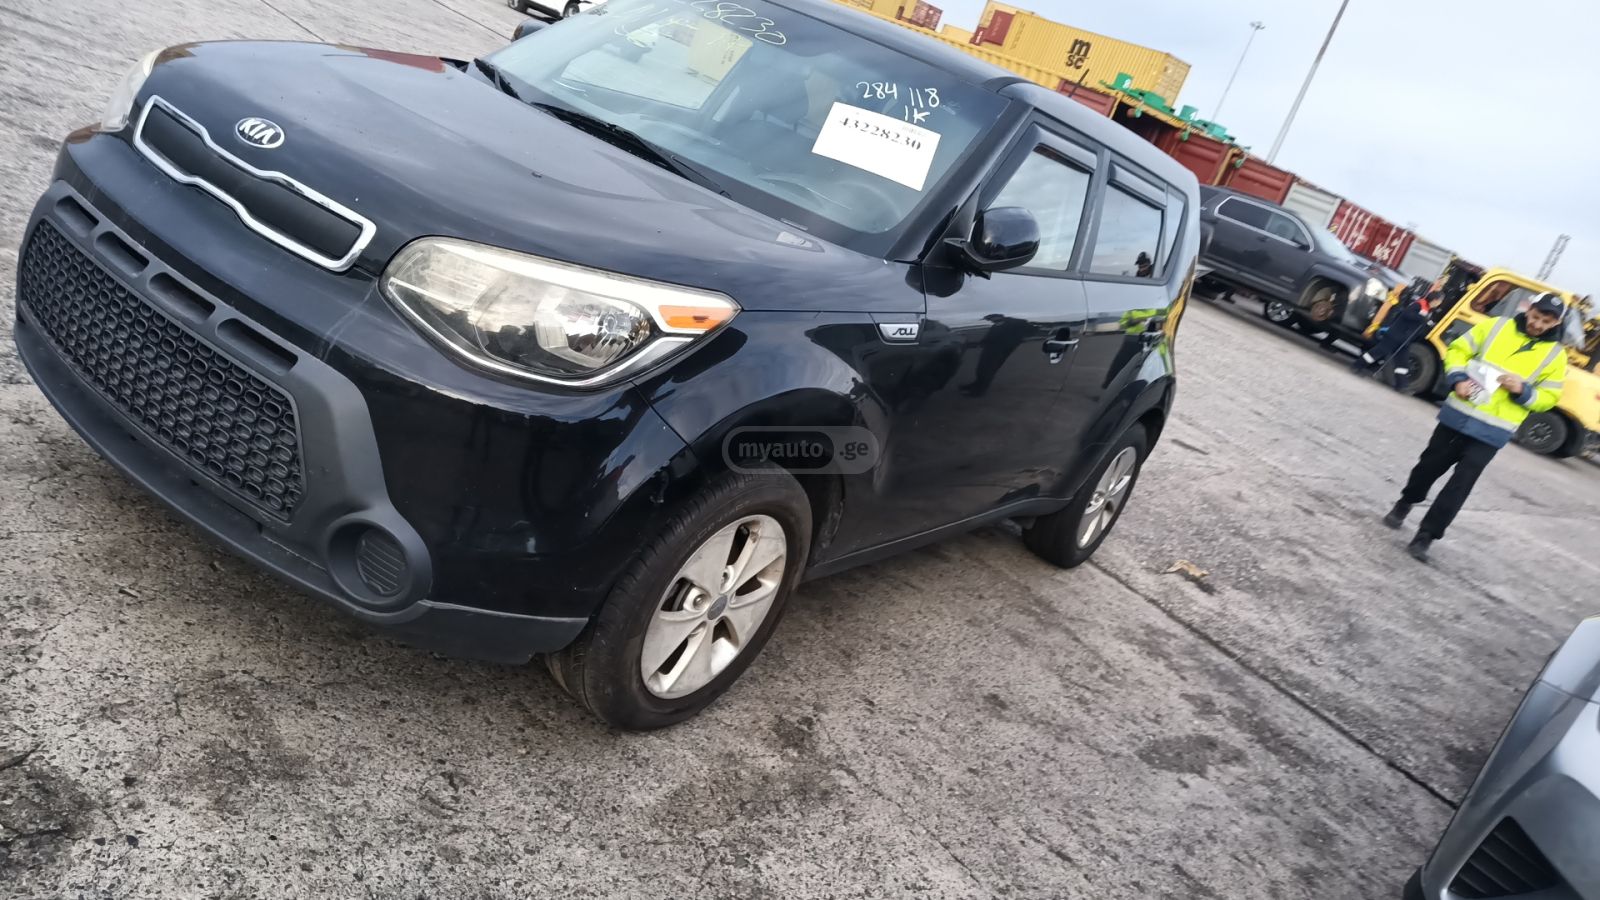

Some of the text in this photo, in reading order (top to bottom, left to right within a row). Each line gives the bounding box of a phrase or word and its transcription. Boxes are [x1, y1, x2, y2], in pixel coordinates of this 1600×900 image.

[855, 81, 940, 108] 284 118
[238, 118, 276, 145] KIA
[840, 117, 922, 151] 43228230
